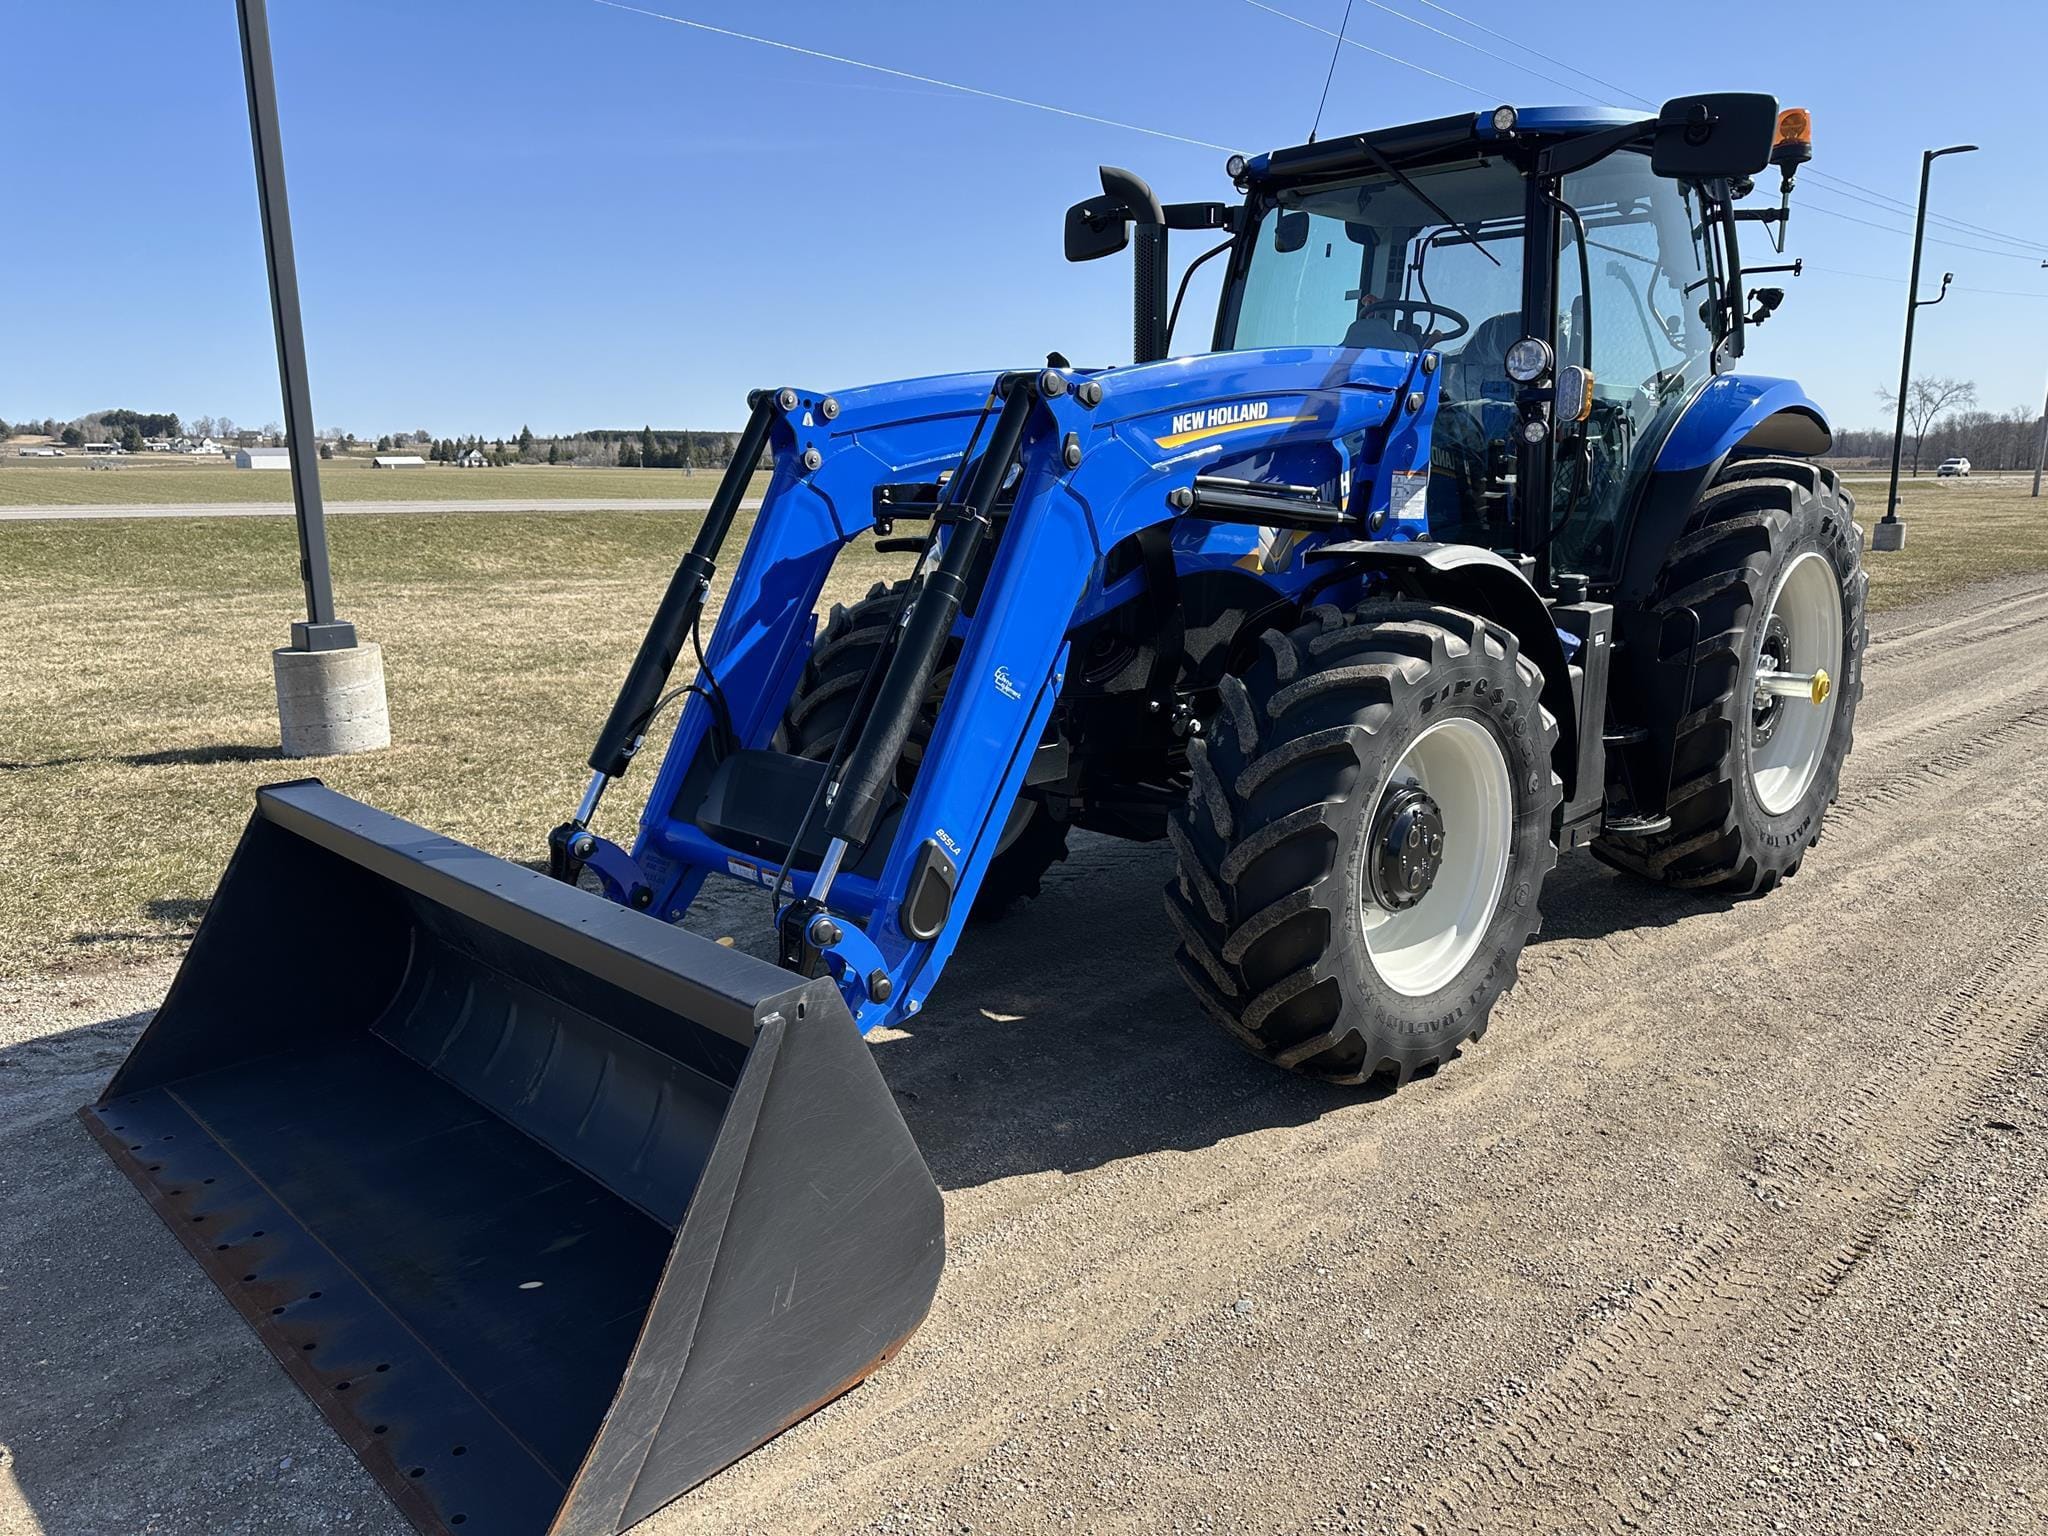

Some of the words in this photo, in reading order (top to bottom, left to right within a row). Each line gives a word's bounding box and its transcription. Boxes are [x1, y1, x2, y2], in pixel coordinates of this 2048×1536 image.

[1172, 410, 1205, 434] NEW
[1207, 401, 1268, 427] HOLLAND
[935, 827, 962, 857] 855LA
